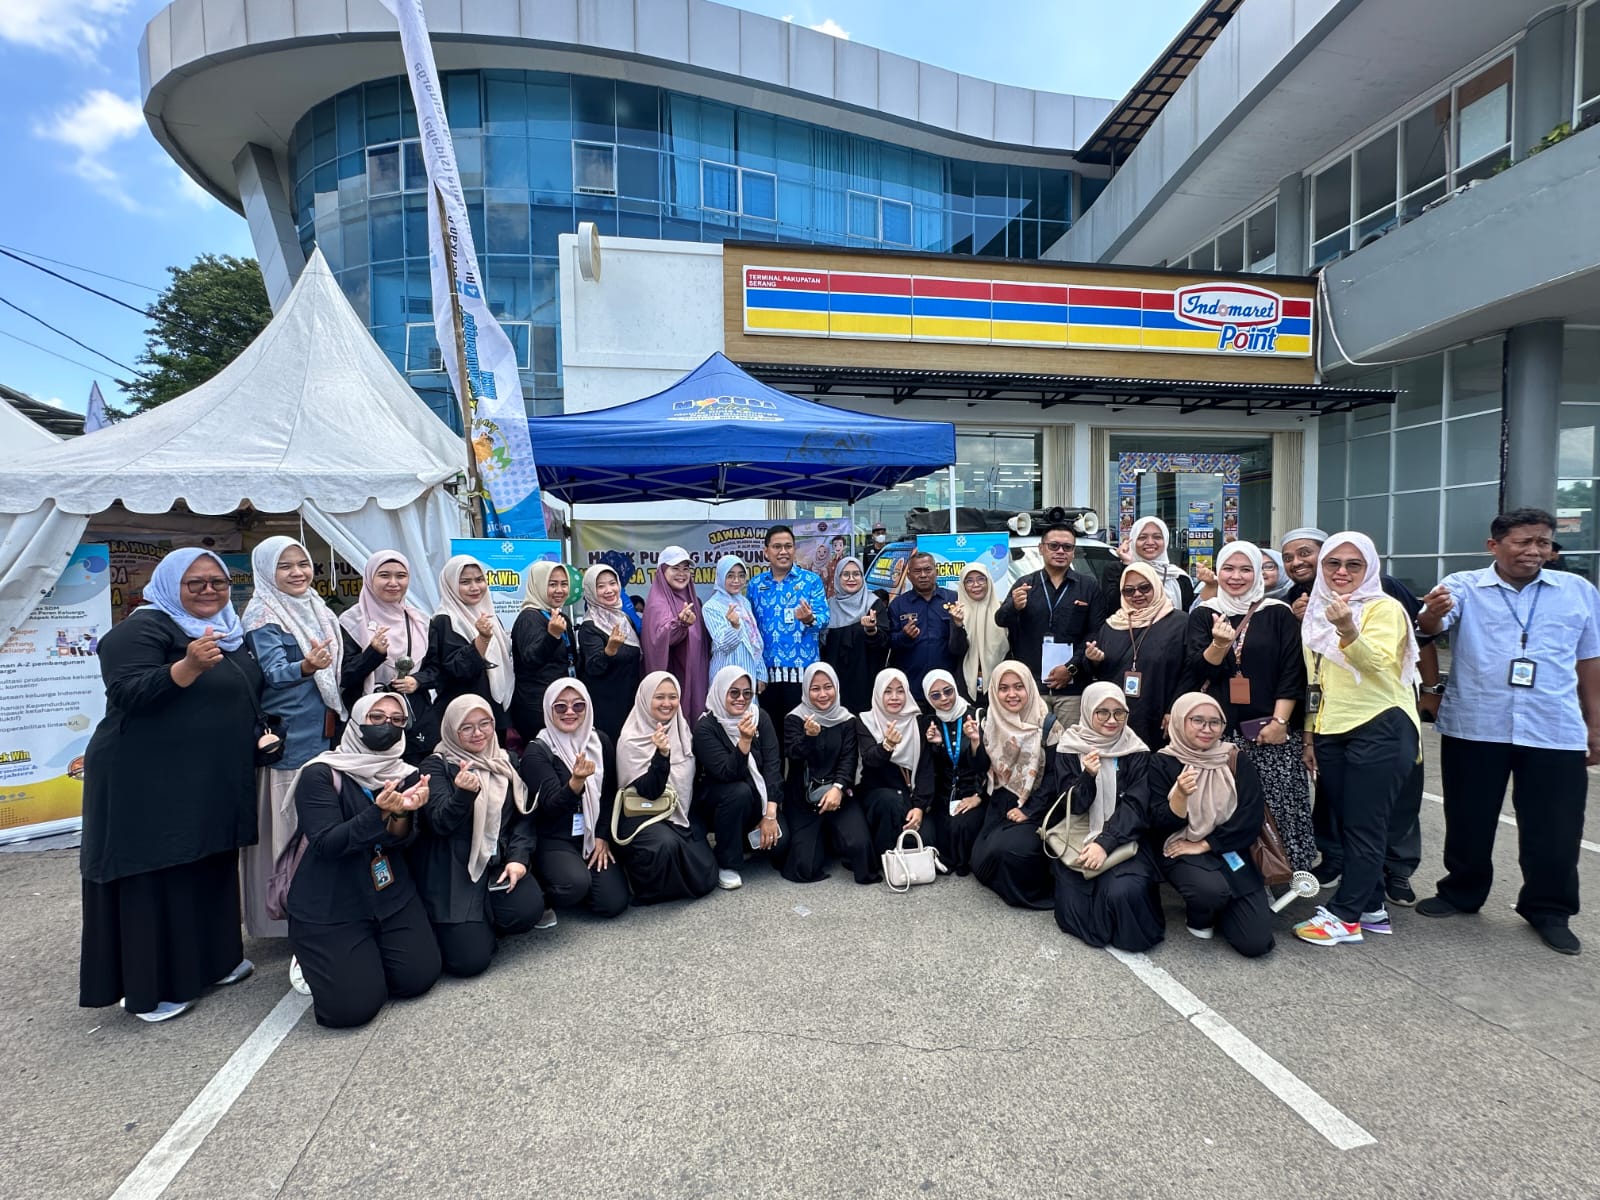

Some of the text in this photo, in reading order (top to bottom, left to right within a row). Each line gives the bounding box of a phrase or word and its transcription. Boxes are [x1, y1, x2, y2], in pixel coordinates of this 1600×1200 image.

[783, 276, 820, 284] PAKUPATAN
[1184, 295, 1274, 318] Indomaret
[1220, 325, 1277, 350] Point
[710, 527, 753, 544] JAWARA
[498, 570, 520, 586] Win
[10, 750, 31, 761] Win
